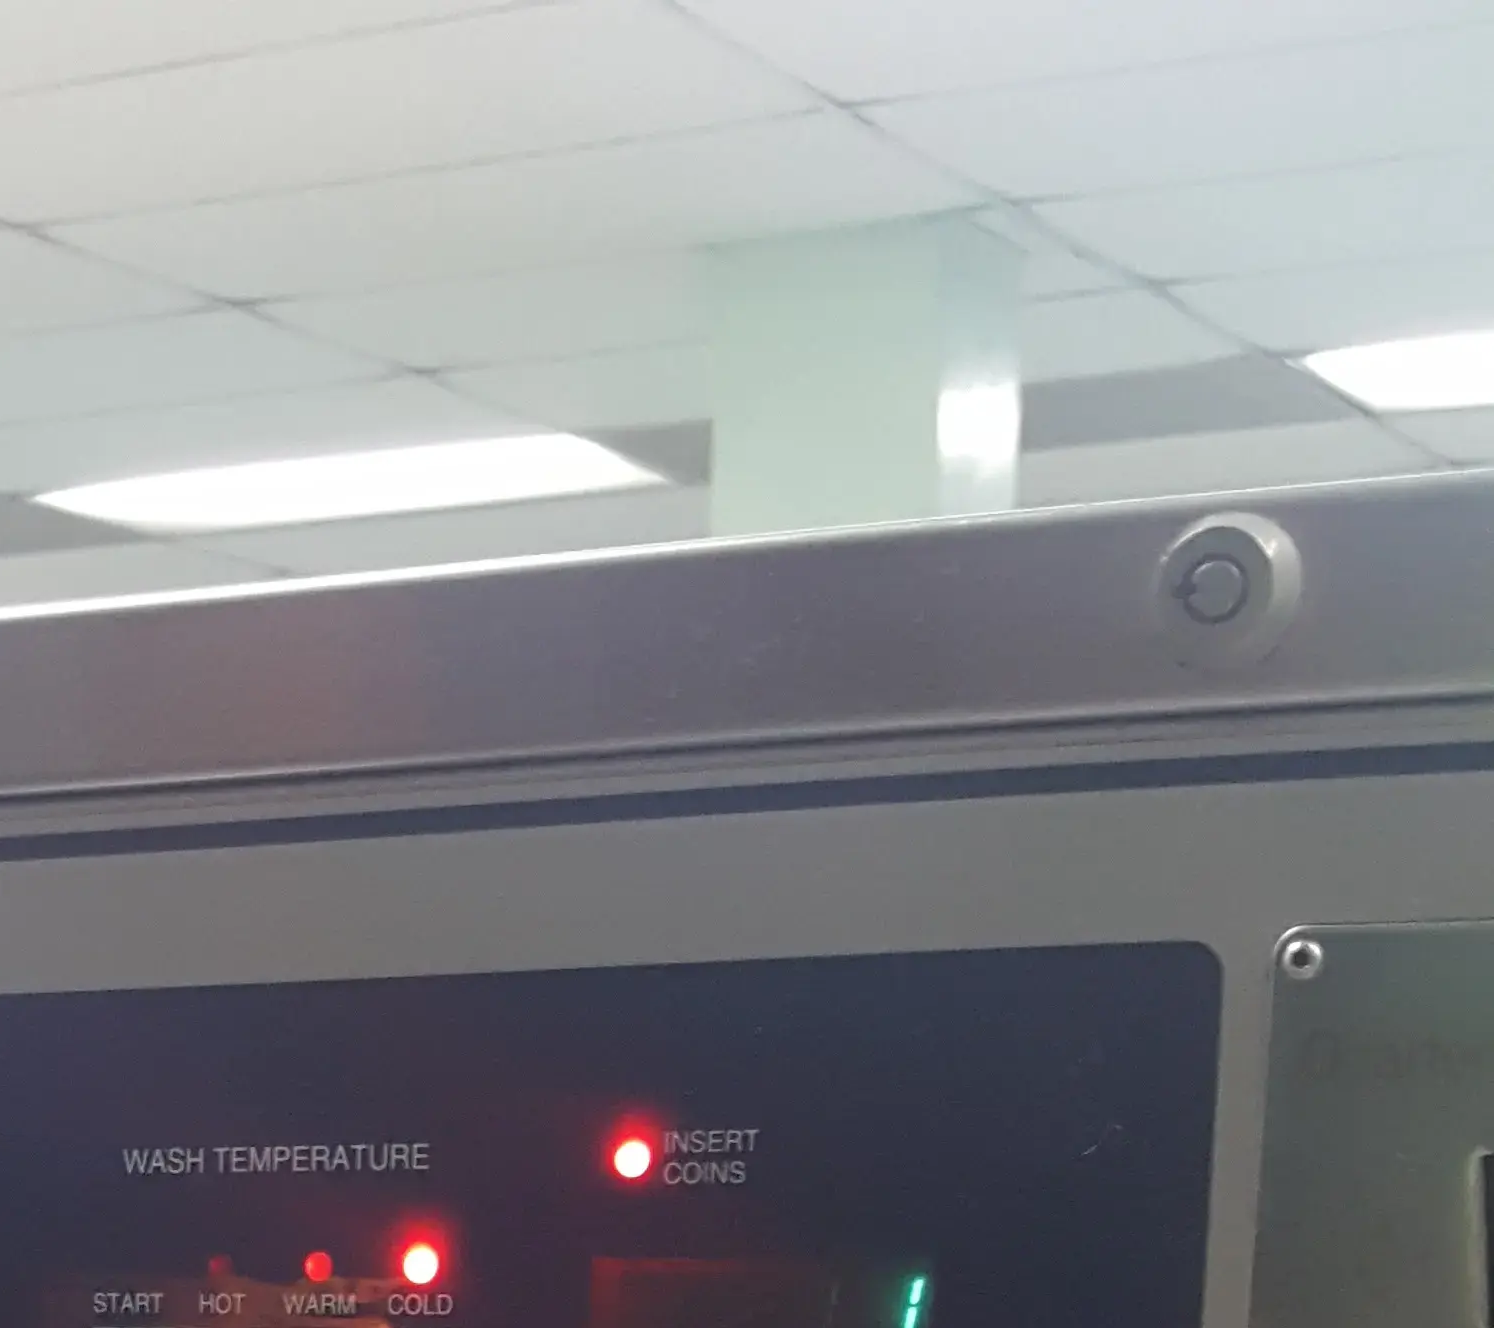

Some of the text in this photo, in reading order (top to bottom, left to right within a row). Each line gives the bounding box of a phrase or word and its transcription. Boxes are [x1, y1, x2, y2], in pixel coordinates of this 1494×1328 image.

[663, 1128, 760, 1154] INSERT
[122, 1143, 430, 1175] WASH TEMPERATURE
[663, 1161, 747, 1185] COINS
[92, 1292, 163, 1314] START
[199, 1293, 246, 1315] HOT
[283, 1293, 356, 1316] WARM
[387, 1293, 454, 1317] COLD
